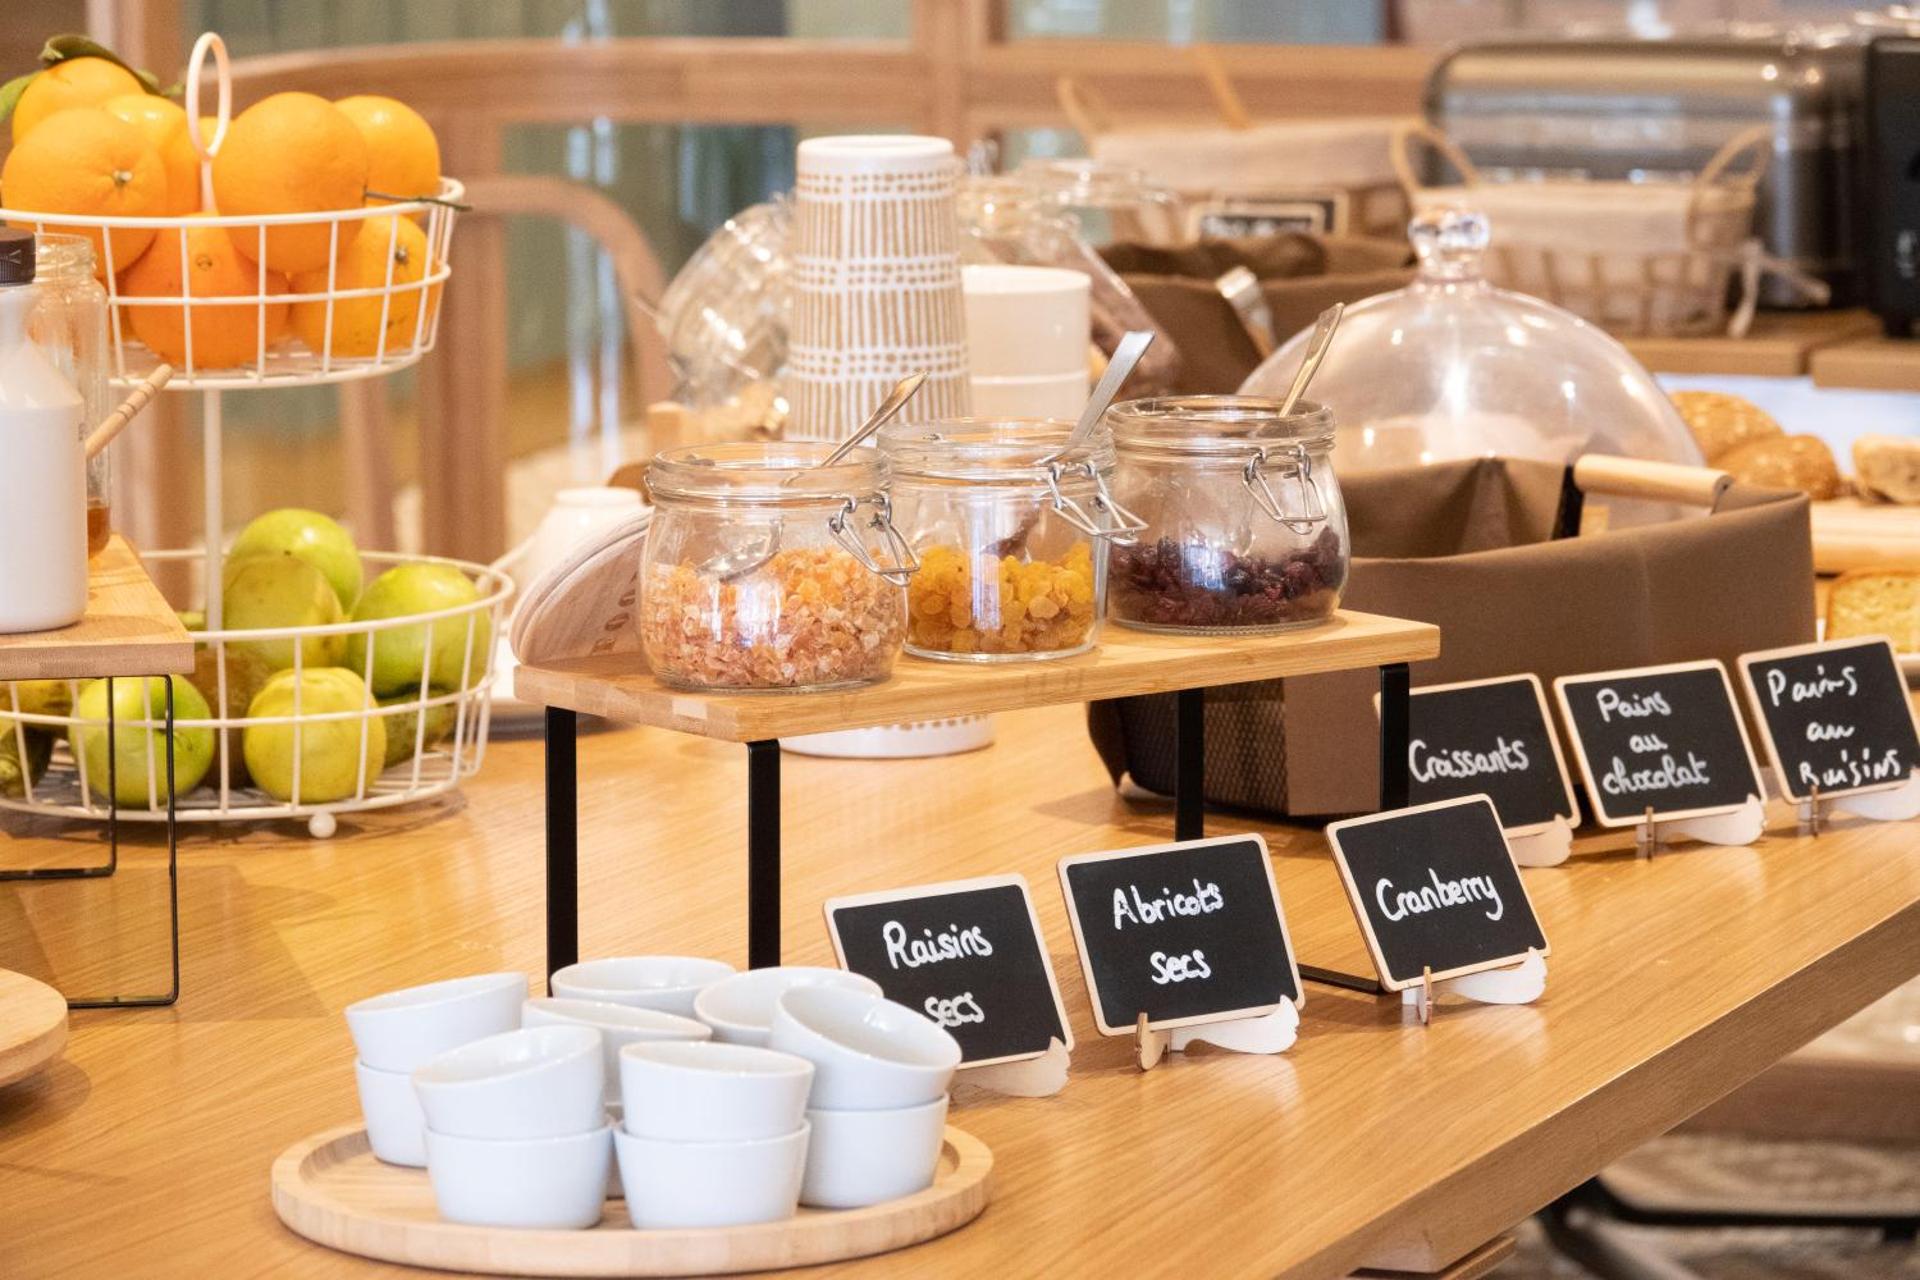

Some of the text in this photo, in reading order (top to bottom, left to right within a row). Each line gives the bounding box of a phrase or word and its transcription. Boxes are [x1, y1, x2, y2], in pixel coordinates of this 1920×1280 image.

[1596, 687, 1672, 723] Pains
[1768, 665, 1858, 707] Pains
[1408, 736, 1529, 783] Croissants
[1629, 733, 1669, 754] au
[1601, 752, 1710, 795] chocolat
[1113, 878, 1224, 930] Abricots
[1375, 867, 1504, 922] Cranberry
[882, 920, 993, 970] Raisins
